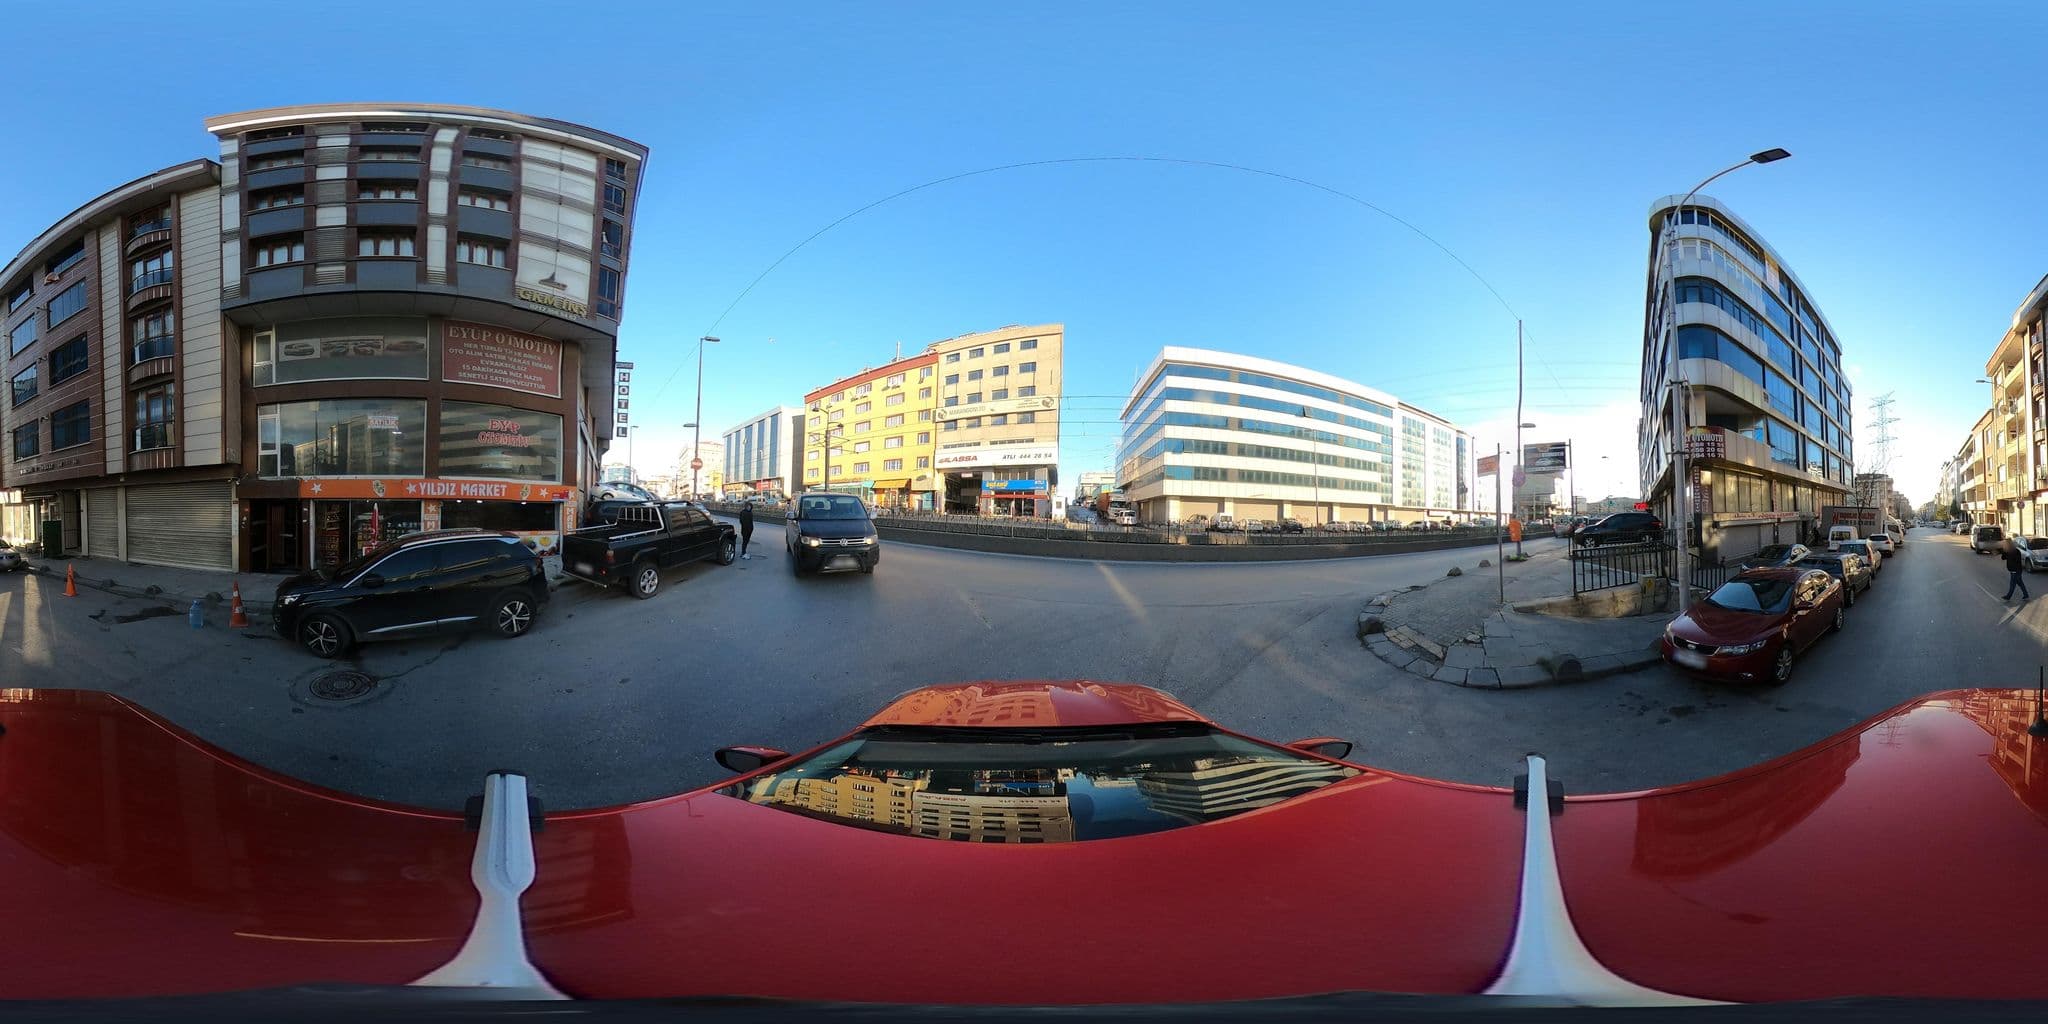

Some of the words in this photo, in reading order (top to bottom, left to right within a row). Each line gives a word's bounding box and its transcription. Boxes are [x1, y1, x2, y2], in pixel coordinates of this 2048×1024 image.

[617, 372, 630, 437] HOTEL
[419, 482, 456, 496] YILDIZ
[460, 483, 508, 497] MARKET
